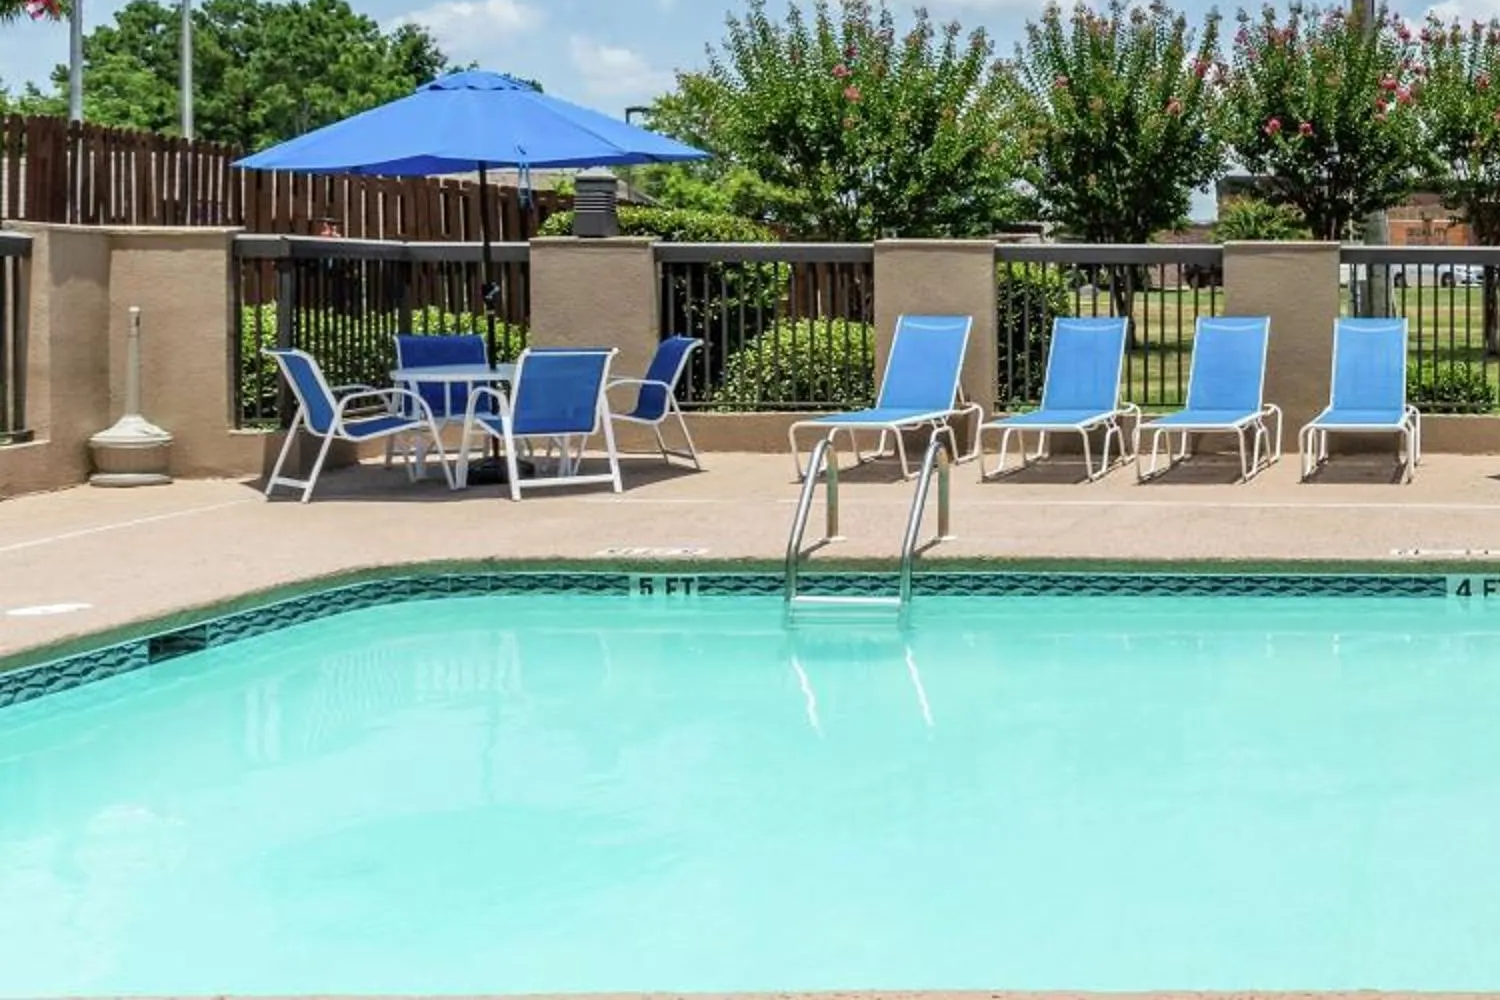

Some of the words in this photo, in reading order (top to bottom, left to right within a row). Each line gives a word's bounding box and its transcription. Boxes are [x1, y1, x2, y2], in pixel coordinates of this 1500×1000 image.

[639, 577, 653, 595] 5
[665, 577, 695, 595] FT
[1456, 578, 1472, 597] 4
